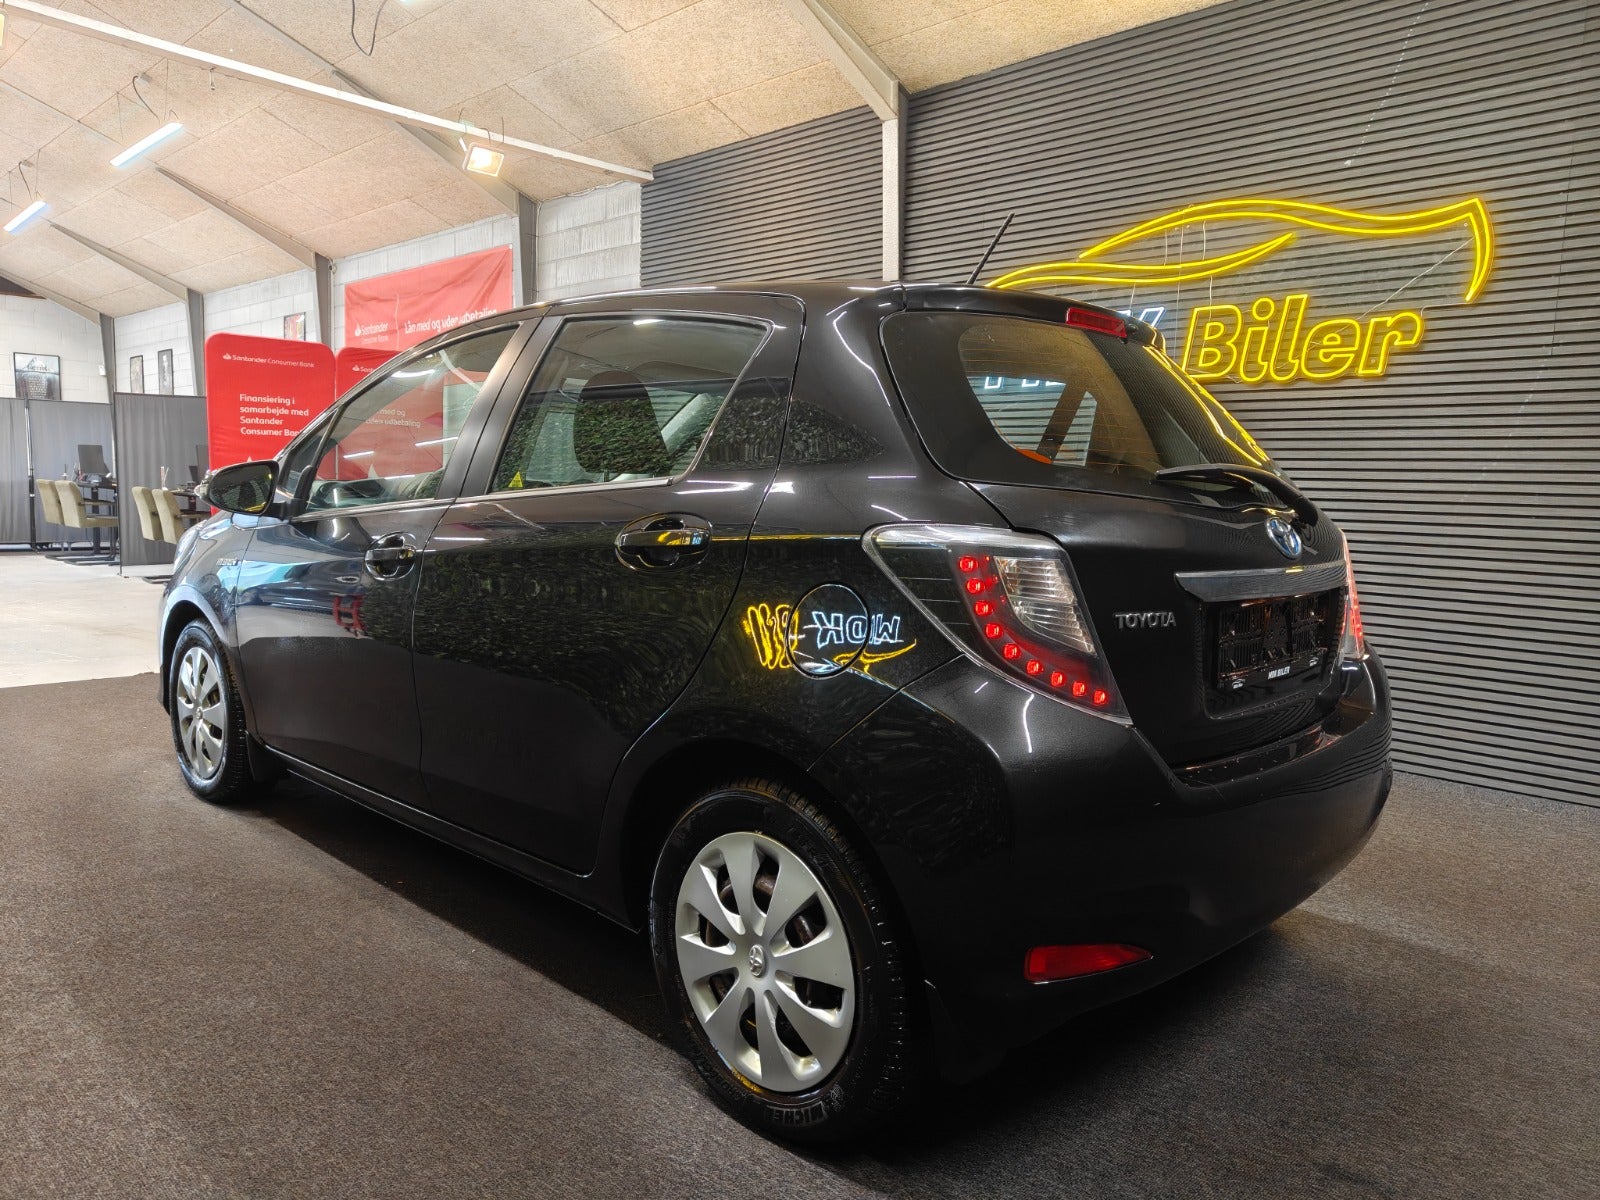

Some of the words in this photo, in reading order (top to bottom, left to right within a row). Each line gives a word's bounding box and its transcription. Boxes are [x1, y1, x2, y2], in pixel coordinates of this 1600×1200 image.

[432, 320, 441, 333] og
[1182, 294, 1424, 382] Biler
[232, 354, 267, 363] Santander
[267, 358, 299, 367] Consumer
[239, 394, 291, 406] Finansiering
[240, 406, 289, 416] samarbejde
[290, 408, 310, 416] med
[240, 415, 284, 425] Santander
[240, 426, 282, 436] Consumer
[284, 428, 302, 437] Ban
[1114, 611, 1177, 630] TOYOTA
